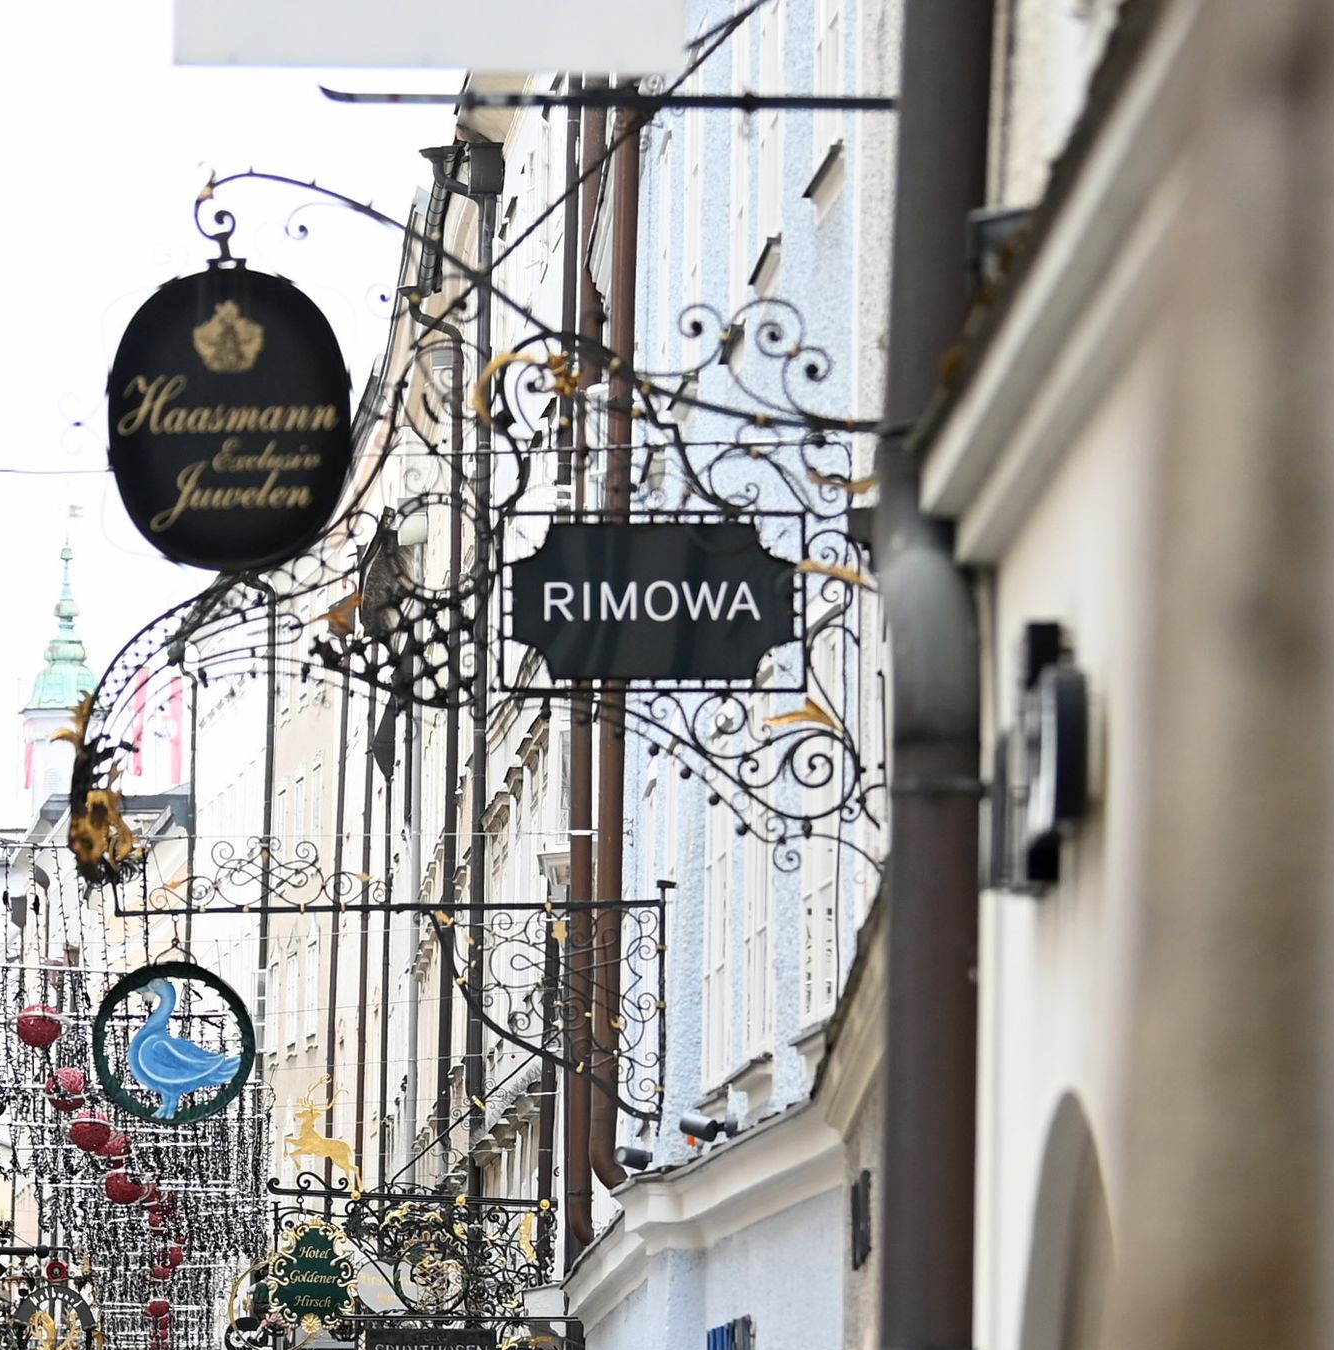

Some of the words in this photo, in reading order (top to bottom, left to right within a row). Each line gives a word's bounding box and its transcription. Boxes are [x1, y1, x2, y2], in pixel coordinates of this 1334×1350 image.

[117, 374, 338, 436] Haasmann
[150, 460, 312, 532] Juwelen
[543, 580, 761, 622] RIMOWA
[297, 1246, 332, 1259] Hotel
[289, 1270, 338, 1284] Goldener
[293, 1295, 332, 1308] Hirsch
